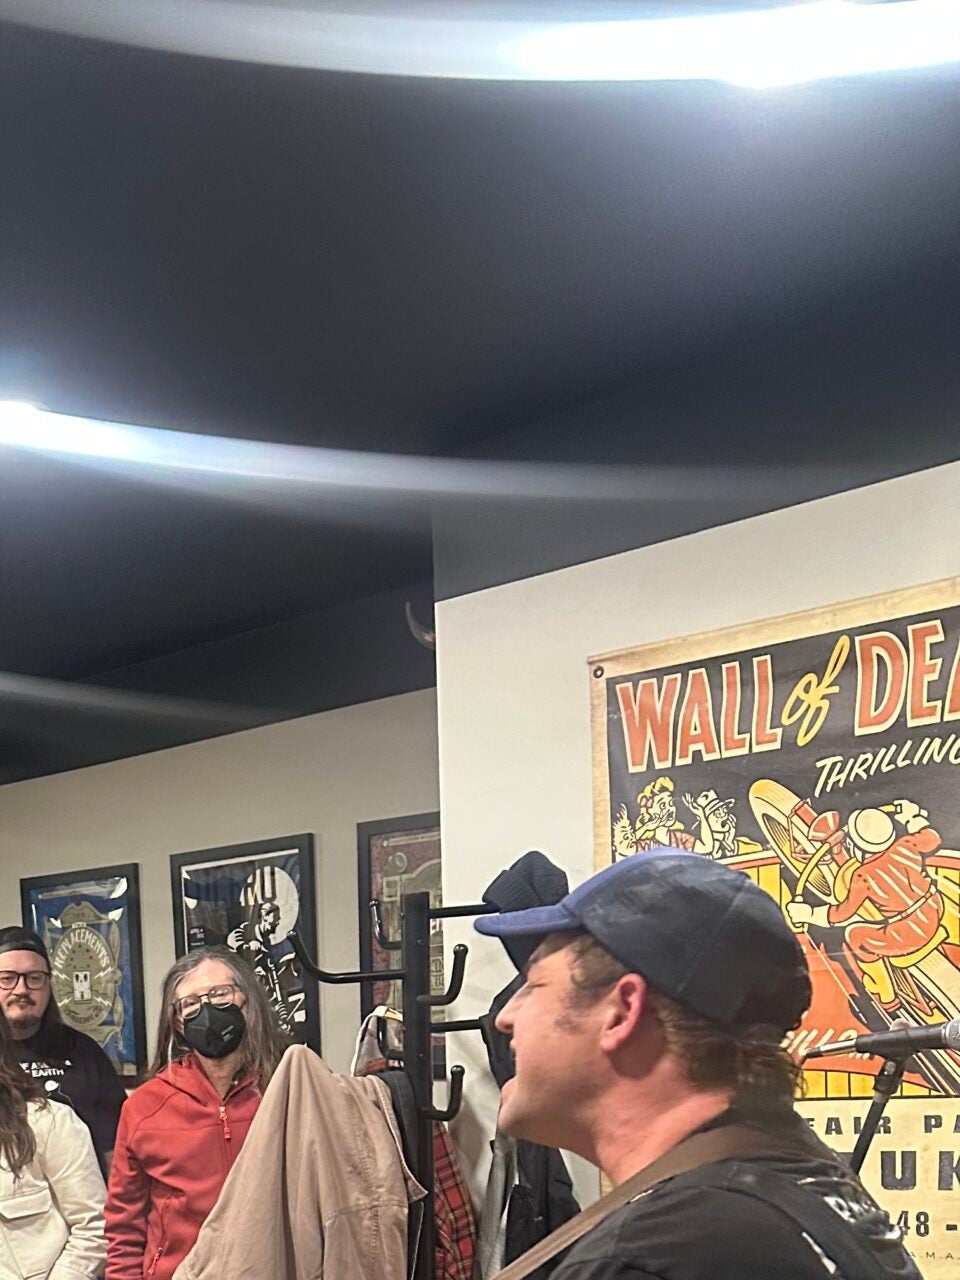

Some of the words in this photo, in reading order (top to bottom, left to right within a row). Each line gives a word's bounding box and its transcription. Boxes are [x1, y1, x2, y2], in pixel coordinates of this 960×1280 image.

[615, 654, 783, 774] WALL
[781, 635, 851, 746] of
[53, 928, 110, 969] REPLACEMENTS
[801, 1115, 892, 1136] AIR
